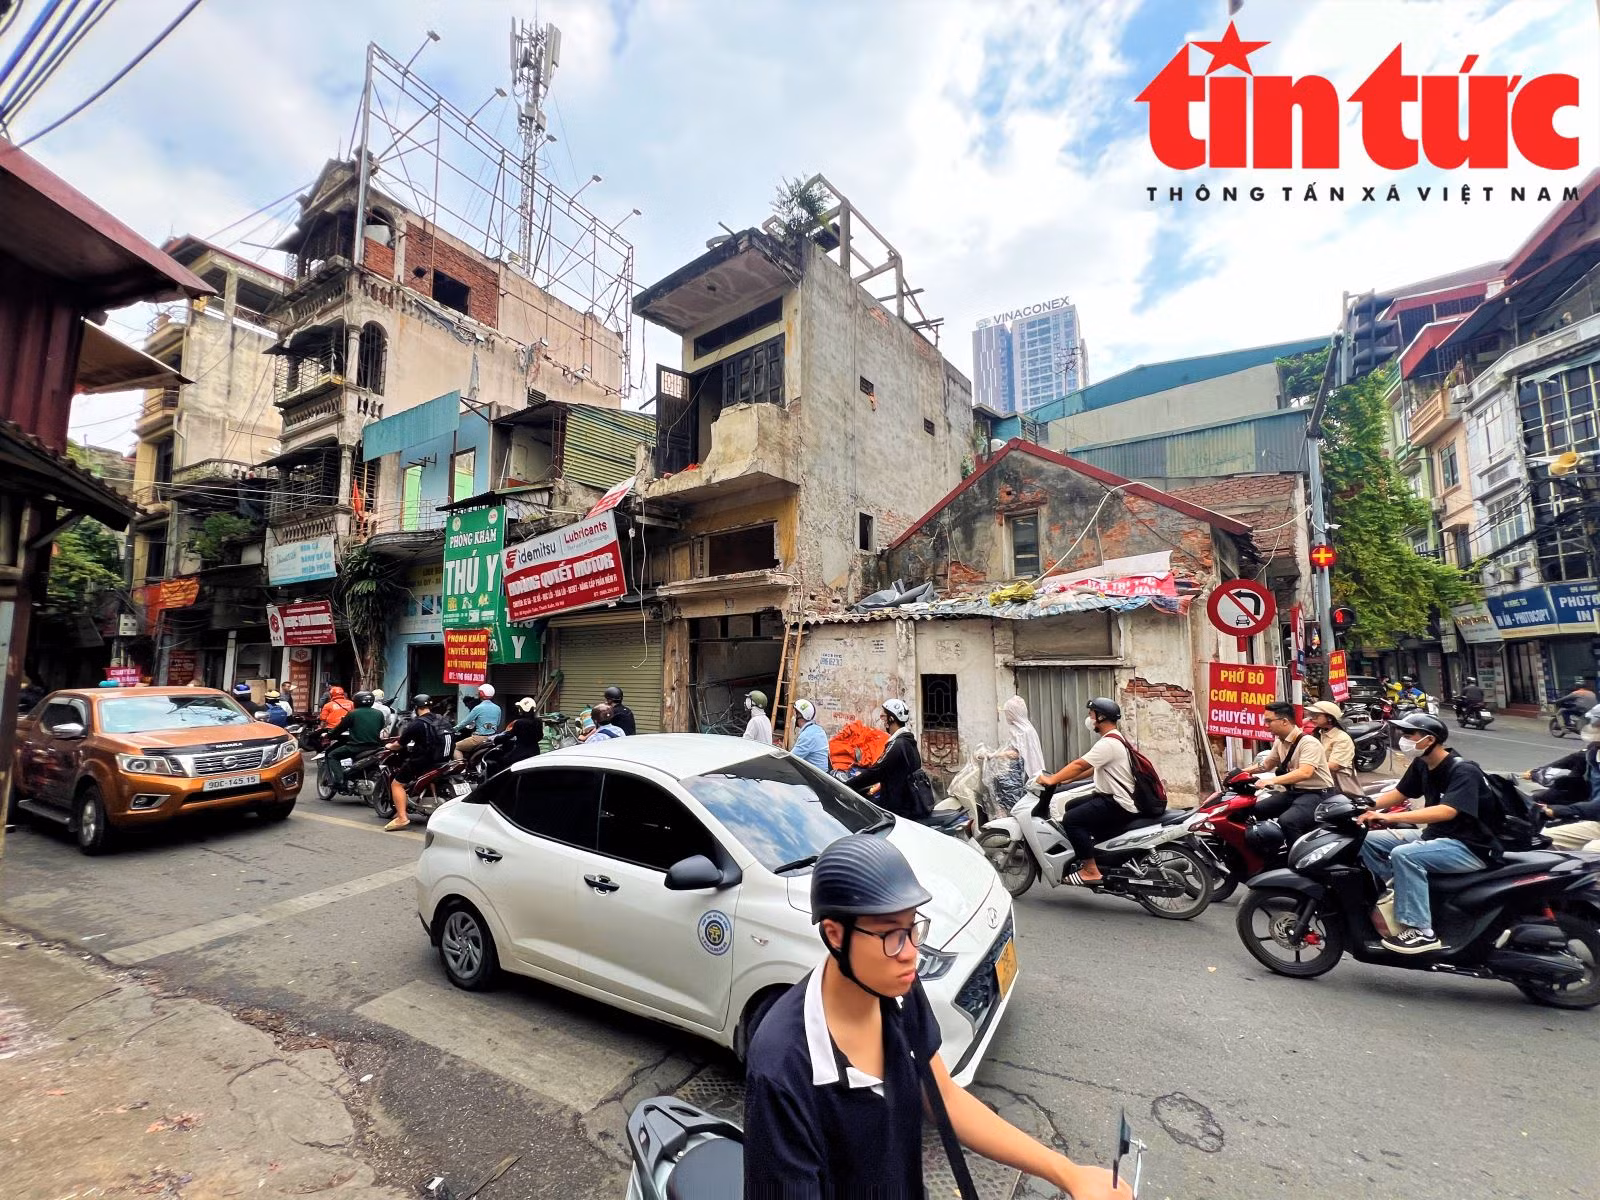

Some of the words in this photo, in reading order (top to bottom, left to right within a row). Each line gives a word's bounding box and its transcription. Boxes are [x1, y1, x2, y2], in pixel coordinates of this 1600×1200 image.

[993, 296, 1070, 324] VINACONEX
[450, 533, 473, 548] PHÒNG
[475, 527, 497, 542] KHÁM
[519, 541, 556, 565] idemitsu
[564, 521, 607, 544] Lubricants
[446, 550, 480, 596] THÚ
[486, 554, 499, 592] Y
[540, 560, 573, 588] QUYẾT
[573, 552, 614, 578] MOTOR
[1220, 668, 1245, 684] PHỞ
[1248, 669, 1265, 685] BÒ
[1210, 689, 1238, 703] CƠM
[1241, 691, 1275, 705] RANG
[1211, 708, 1255, 725] CHUYỂN
